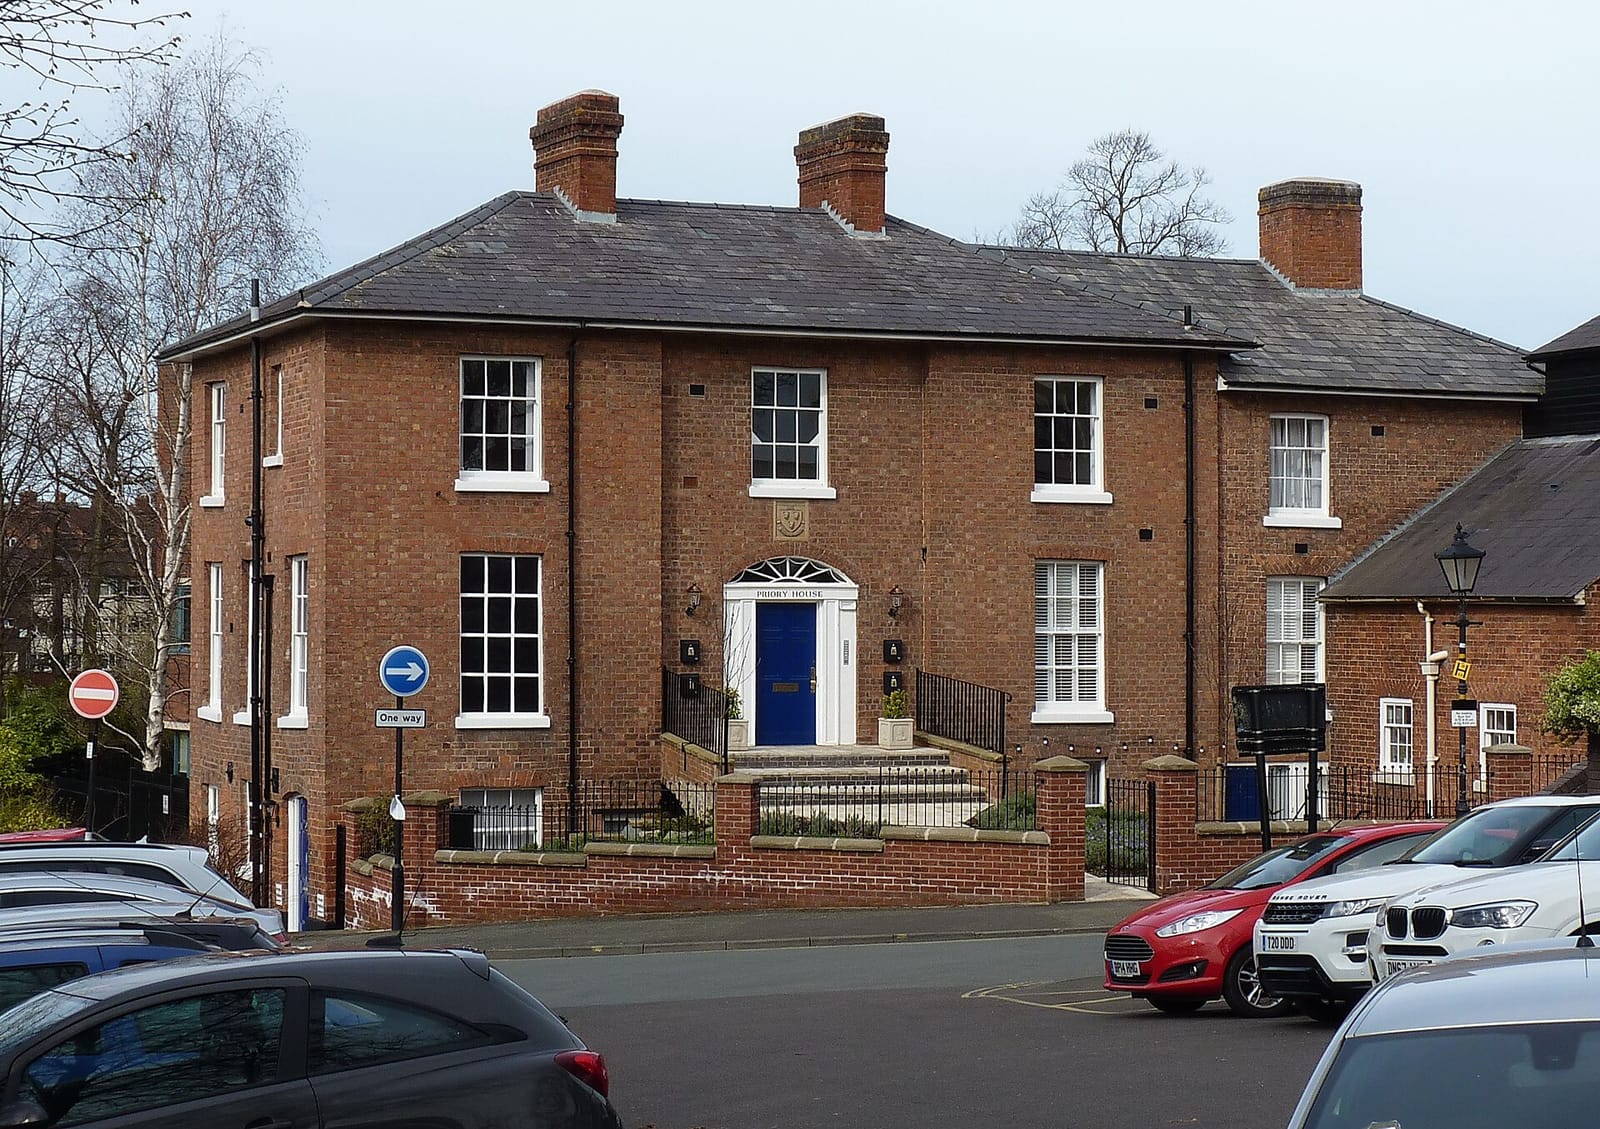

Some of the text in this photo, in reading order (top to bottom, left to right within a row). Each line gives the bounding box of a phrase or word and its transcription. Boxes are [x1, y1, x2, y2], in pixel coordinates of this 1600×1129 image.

[756, 590, 824, 598] PRIORY HOUSE
[379, 713, 422, 724] One way
[1268, 936, 1279, 949] T20
